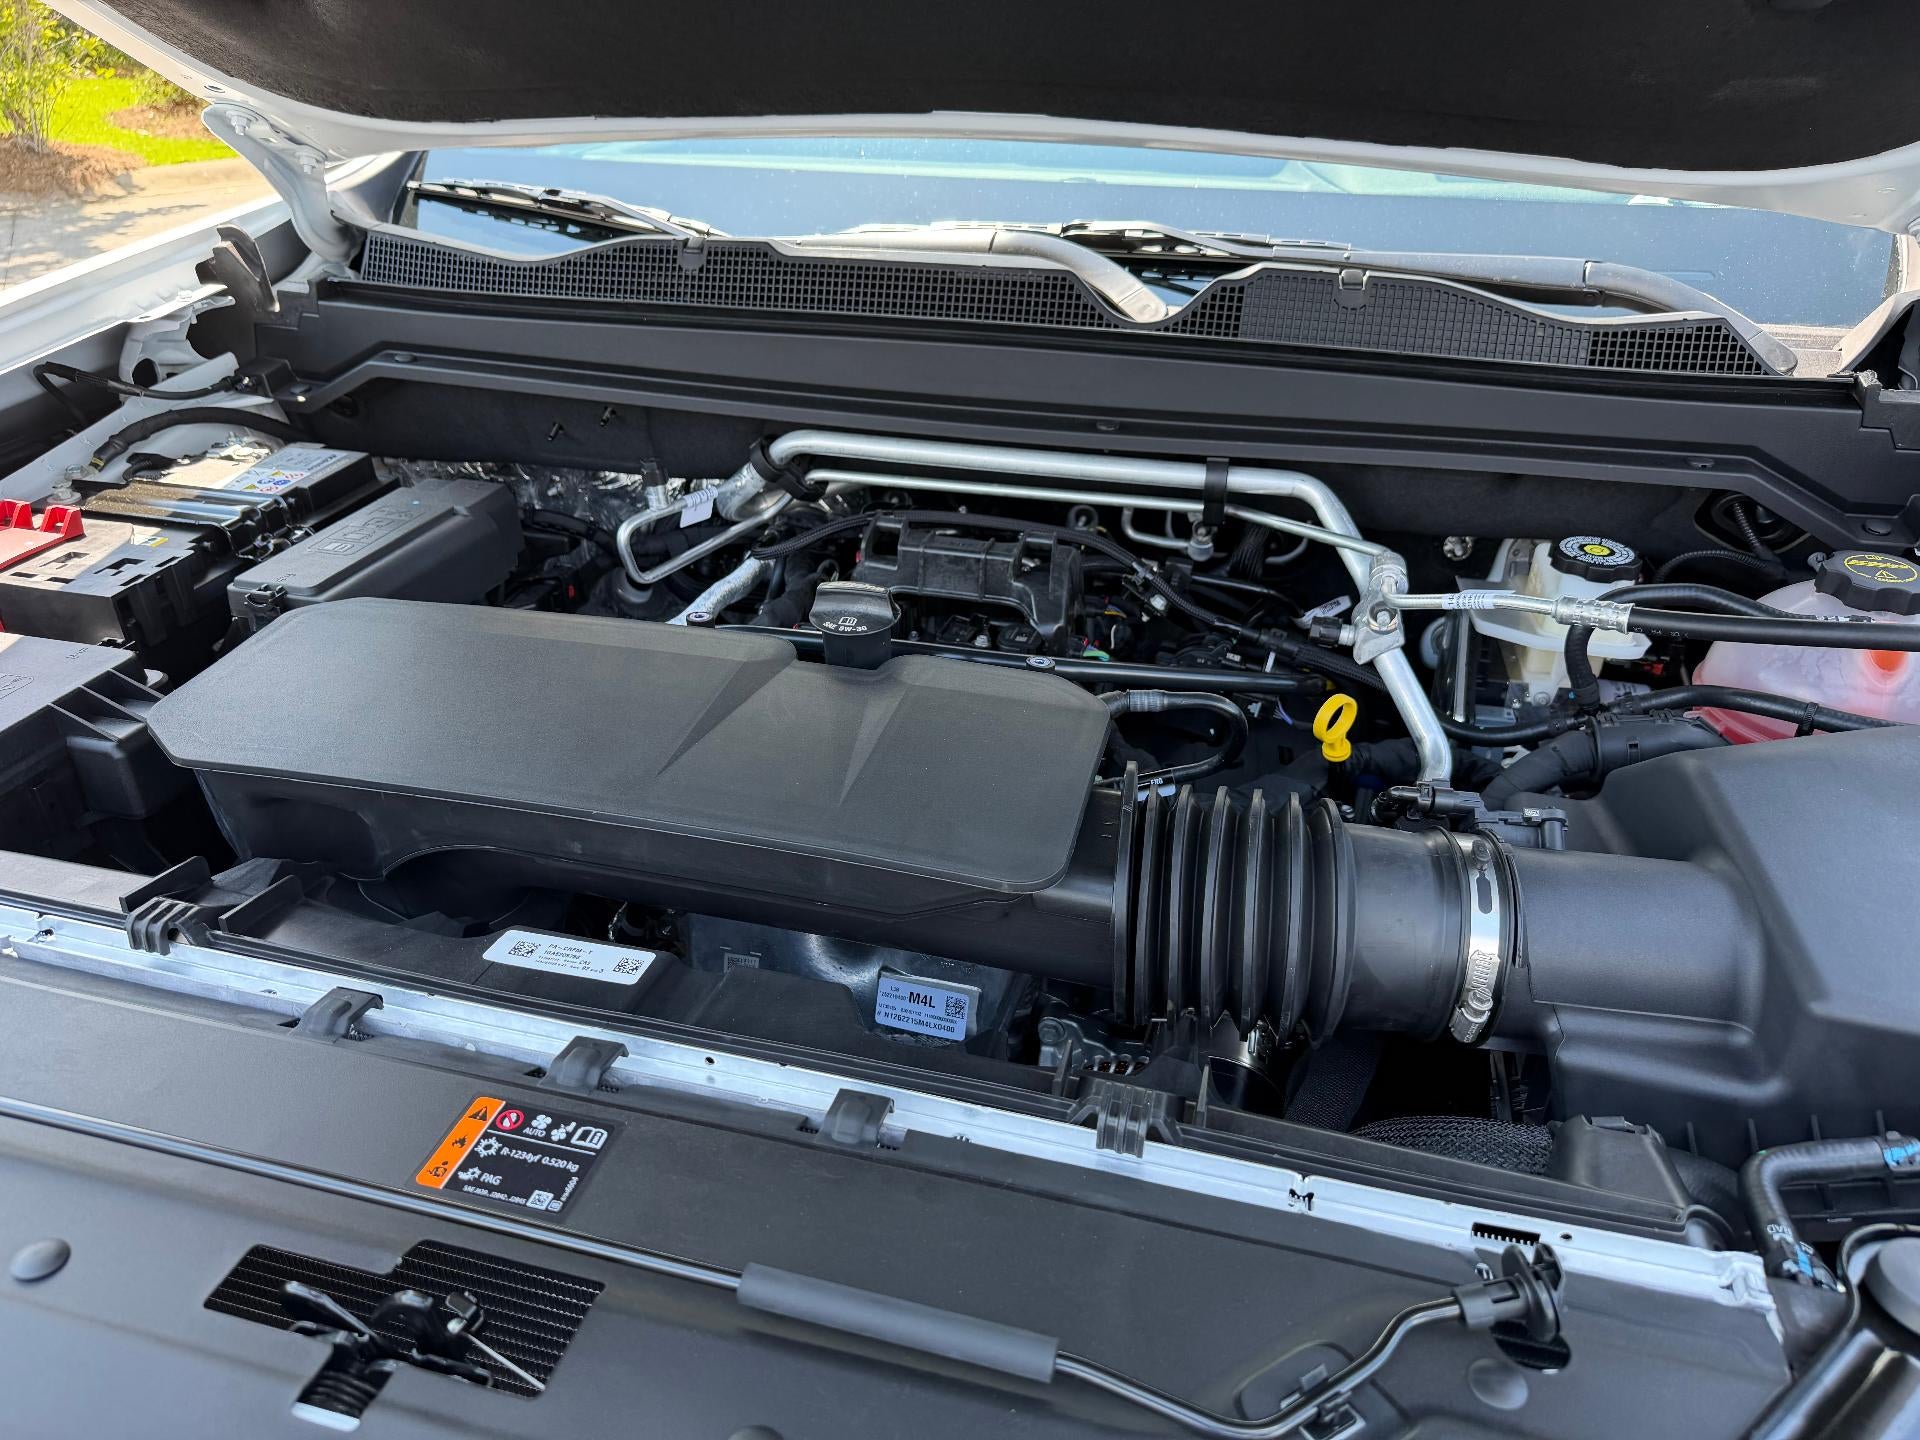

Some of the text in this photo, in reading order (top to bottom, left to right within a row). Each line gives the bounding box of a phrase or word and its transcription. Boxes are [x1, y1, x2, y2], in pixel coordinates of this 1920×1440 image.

[822, 621, 837, 630] SAE
[908, 991, 936, 1009] M4L
[523, 1127, 546, 1138] AUTO
[500, 1147, 580, 1173] R-1234yf 0.520 kg
[480, 1172, 503, 1186] PAG
